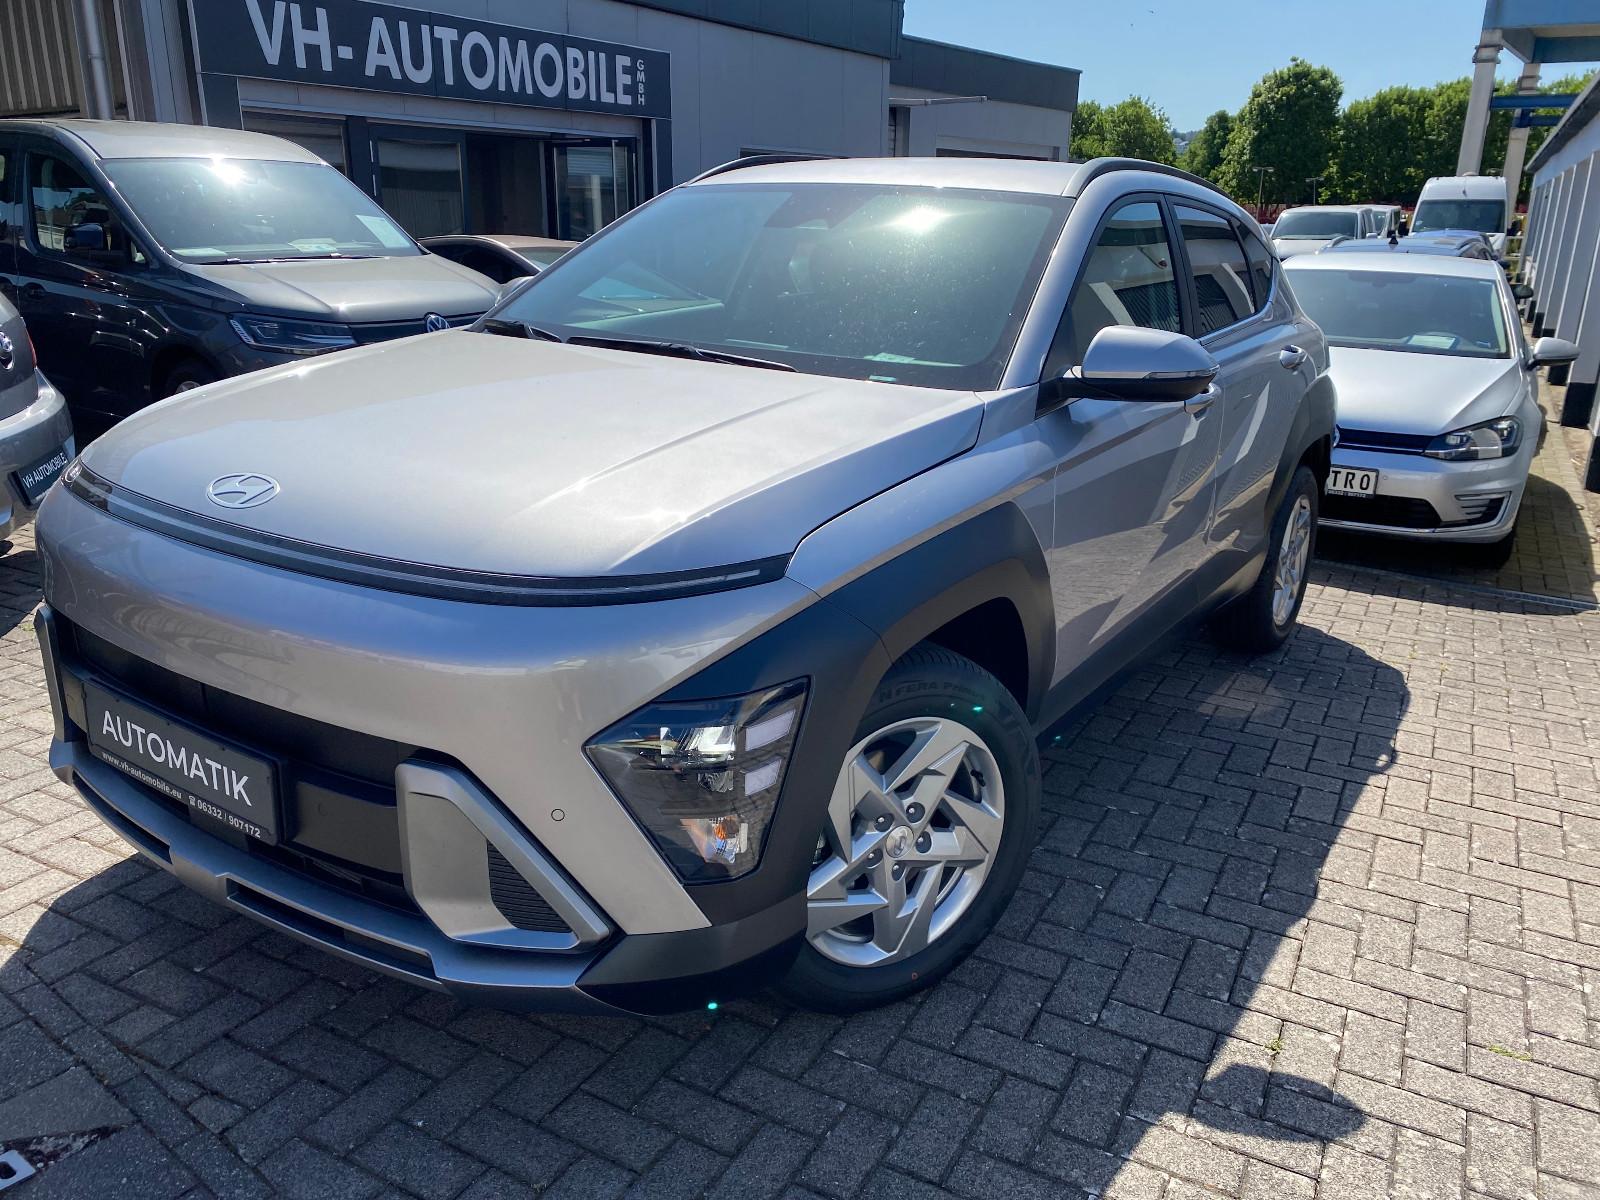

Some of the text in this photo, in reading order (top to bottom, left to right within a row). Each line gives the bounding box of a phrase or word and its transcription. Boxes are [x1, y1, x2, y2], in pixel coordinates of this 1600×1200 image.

[365, 17, 632, 105] AUTOMOBILE
[636, 59, 645, 106] GMBH
[23, 452, 68, 488] VH AUTOMOBILE
[102, 711, 252, 806] AUTOMATIK
[102, 752, 182, 799] www.vh-automobile.eu
[197, 800, 222, 820] 06332
[228, 815, 261, 838] 907172
